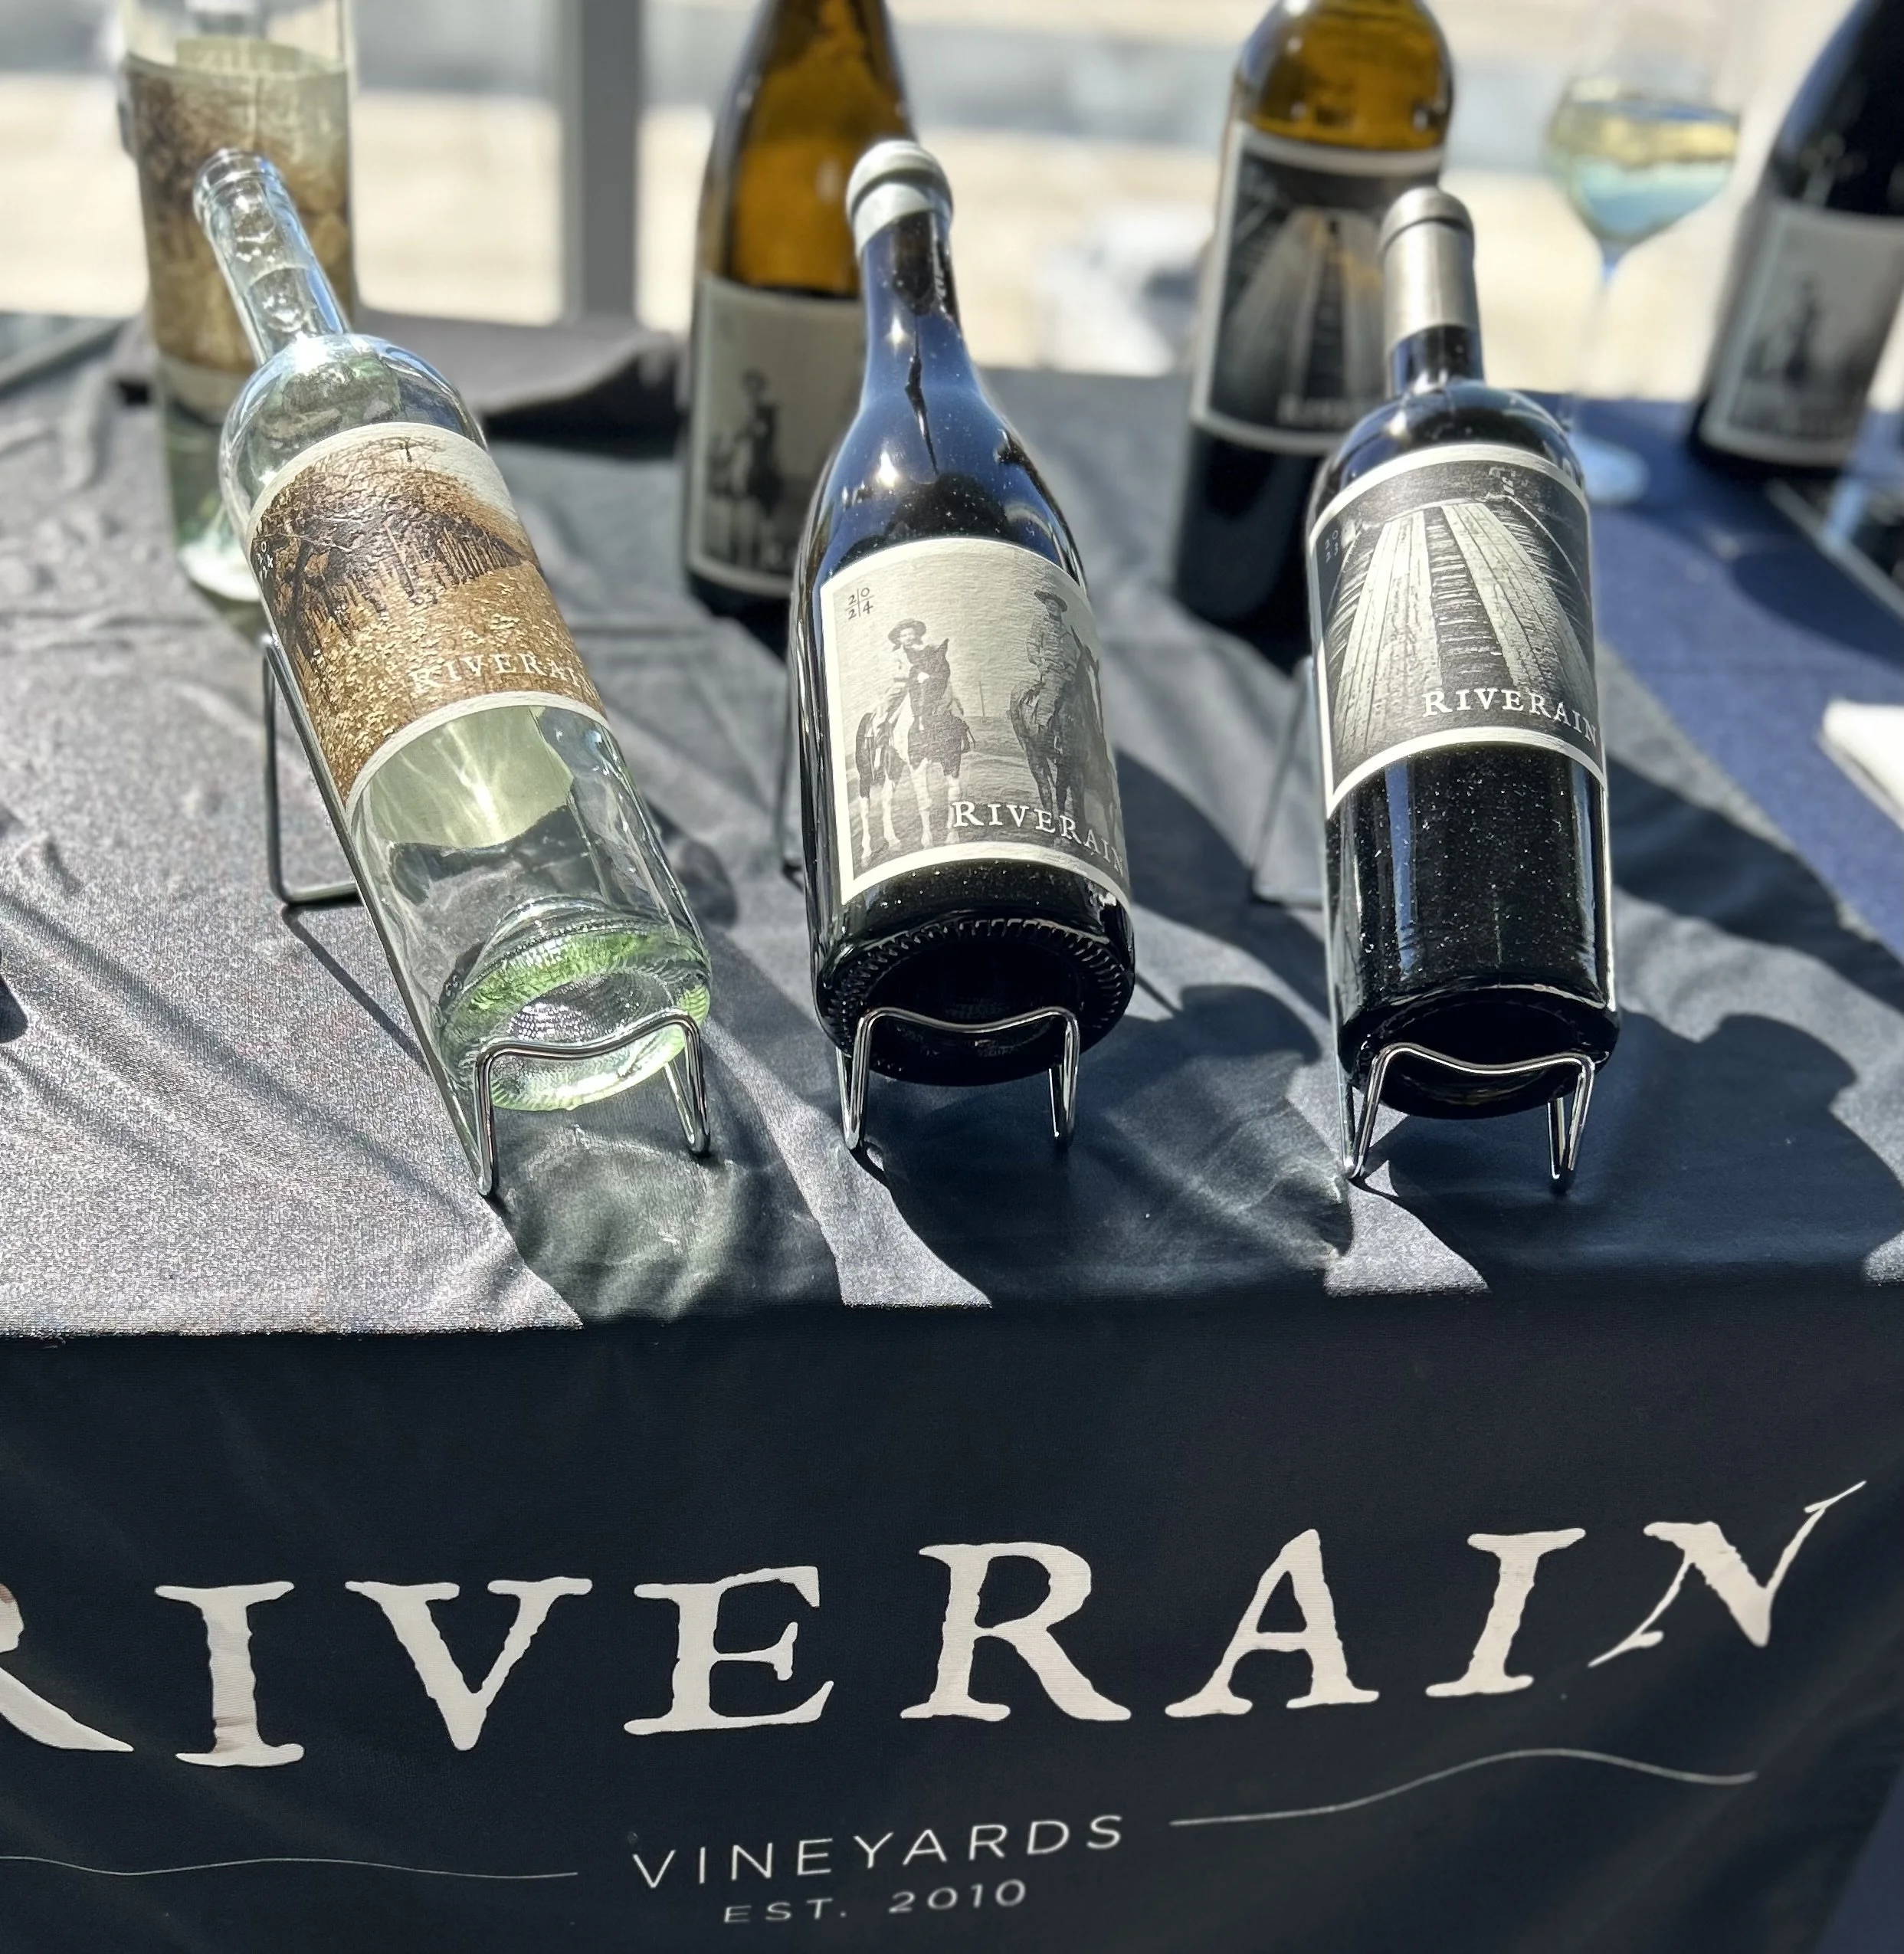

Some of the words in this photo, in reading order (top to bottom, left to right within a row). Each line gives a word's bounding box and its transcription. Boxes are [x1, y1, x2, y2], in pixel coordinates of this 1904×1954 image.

[1422, 688, 1596, 747] RIVERAIN
[952, 802, 1124, 877] RIVERAIN
[634, 1815, 1122, 1888] VINEYARDS
[724, 1898, 846, 1923] EST.
[889, 1879, 1026, 1914] 2010
